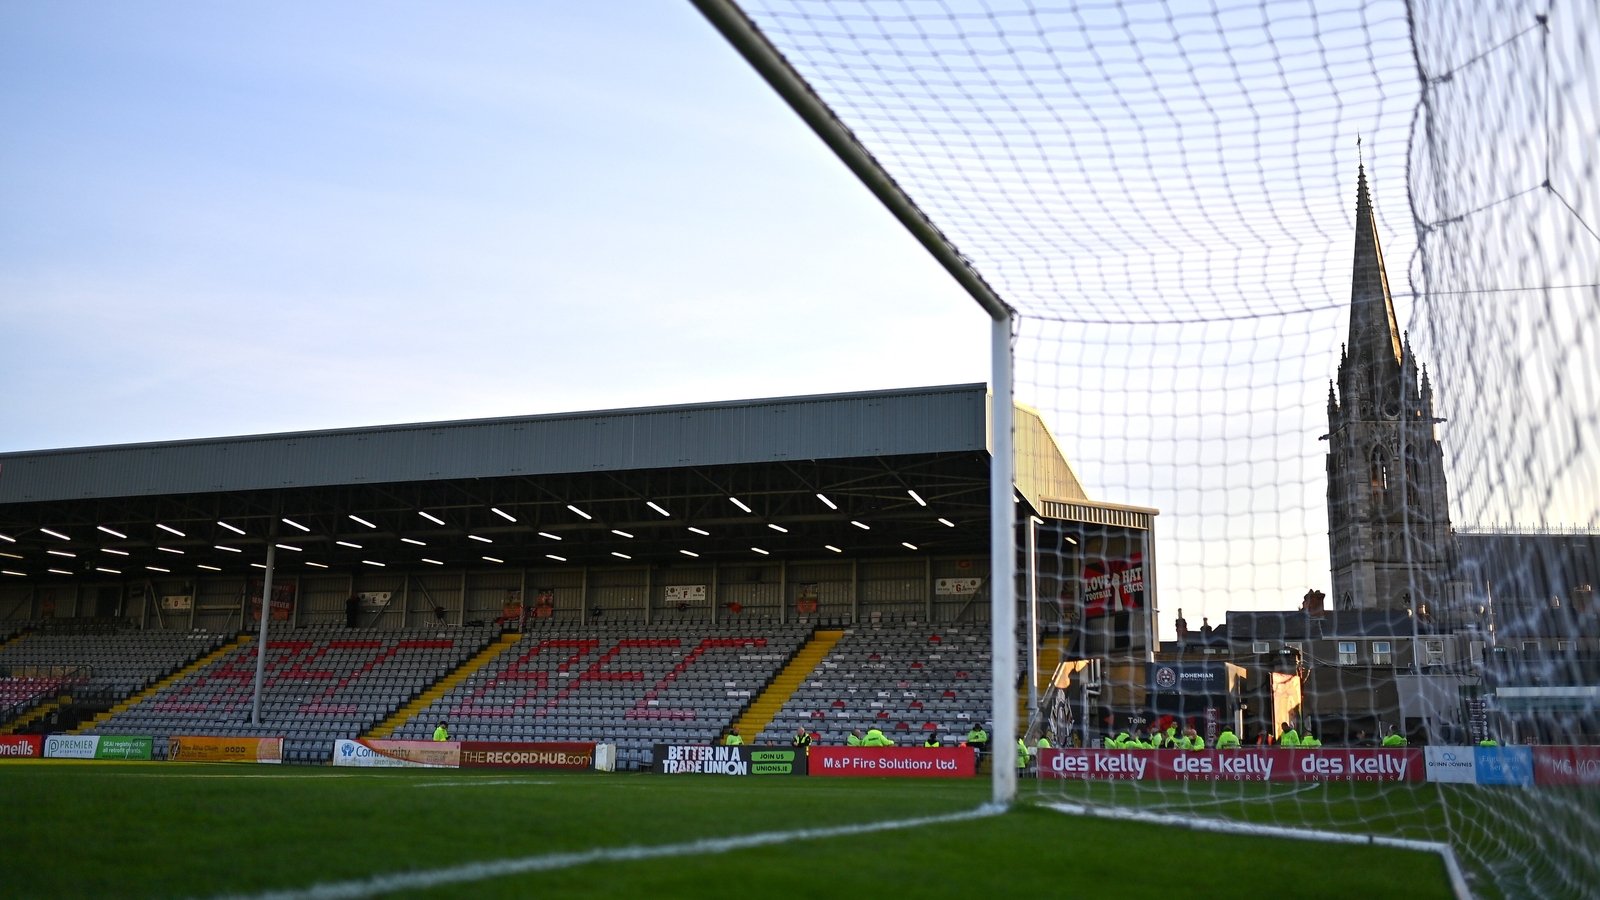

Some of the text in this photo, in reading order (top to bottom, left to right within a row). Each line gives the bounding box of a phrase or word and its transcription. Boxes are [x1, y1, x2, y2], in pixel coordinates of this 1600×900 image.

[1084, 574, 1111, 592] LOVE
[1121, 567, 1142, 584] HAT
[1123, 581, 1144, 594] RACIS
[60, 740, 93, 749] PREMIER
[356, 746, 411, 758] Community
[668, 745, 740, 761] BETTER IN A
[663, 760, 748, 776] TRADE UNION
[756, 763, 788, 772] UNIONS.IE
[853, 758, 876, 768] Fire
[879, 758, 932, 770] Solutions
[935, 759, 958, 770] Ltd.
[1051, 752, 1147, 780] des kelly
[1172, 753, 1273, 781] des kelly
[1301, 753, 1408, 781] des kelly
[1552, 759, 1573, 775] MG
